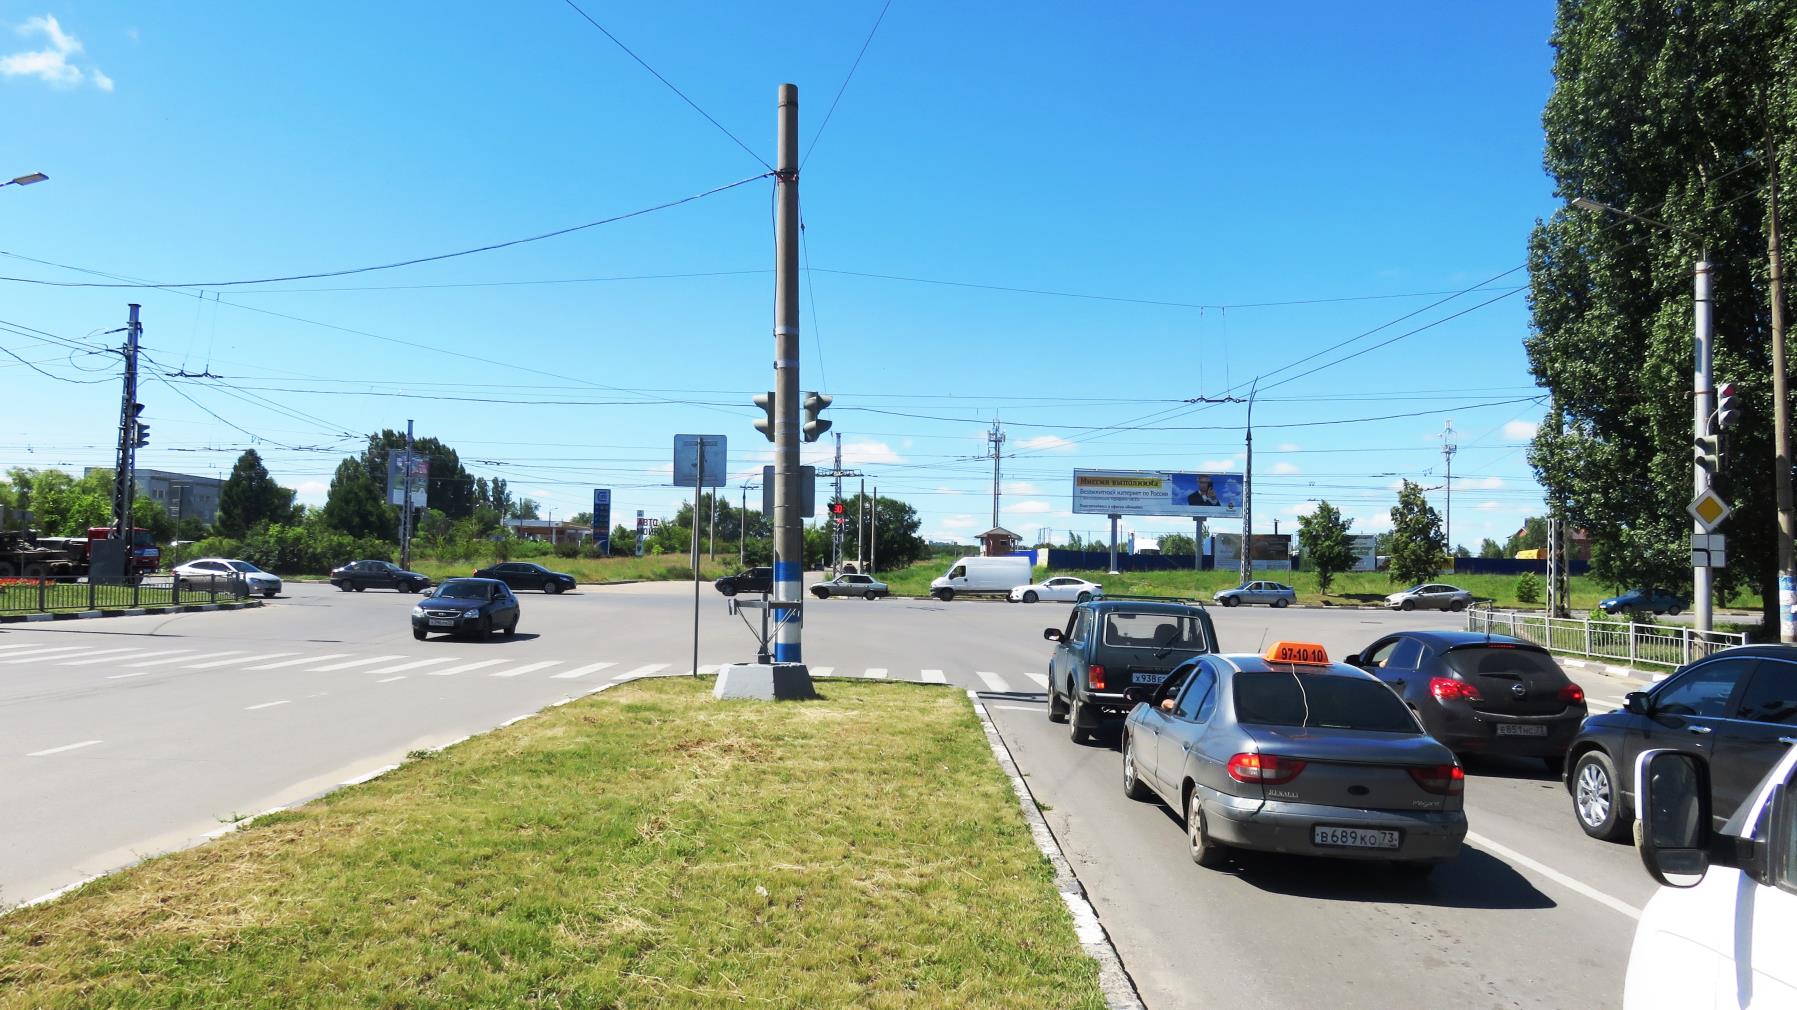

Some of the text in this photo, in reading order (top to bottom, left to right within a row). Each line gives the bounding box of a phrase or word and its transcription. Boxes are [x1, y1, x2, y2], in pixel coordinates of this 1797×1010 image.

[1080, 476, 1159, 488] Миссия выполнима
[1311, 649, 1323, 662] 10
